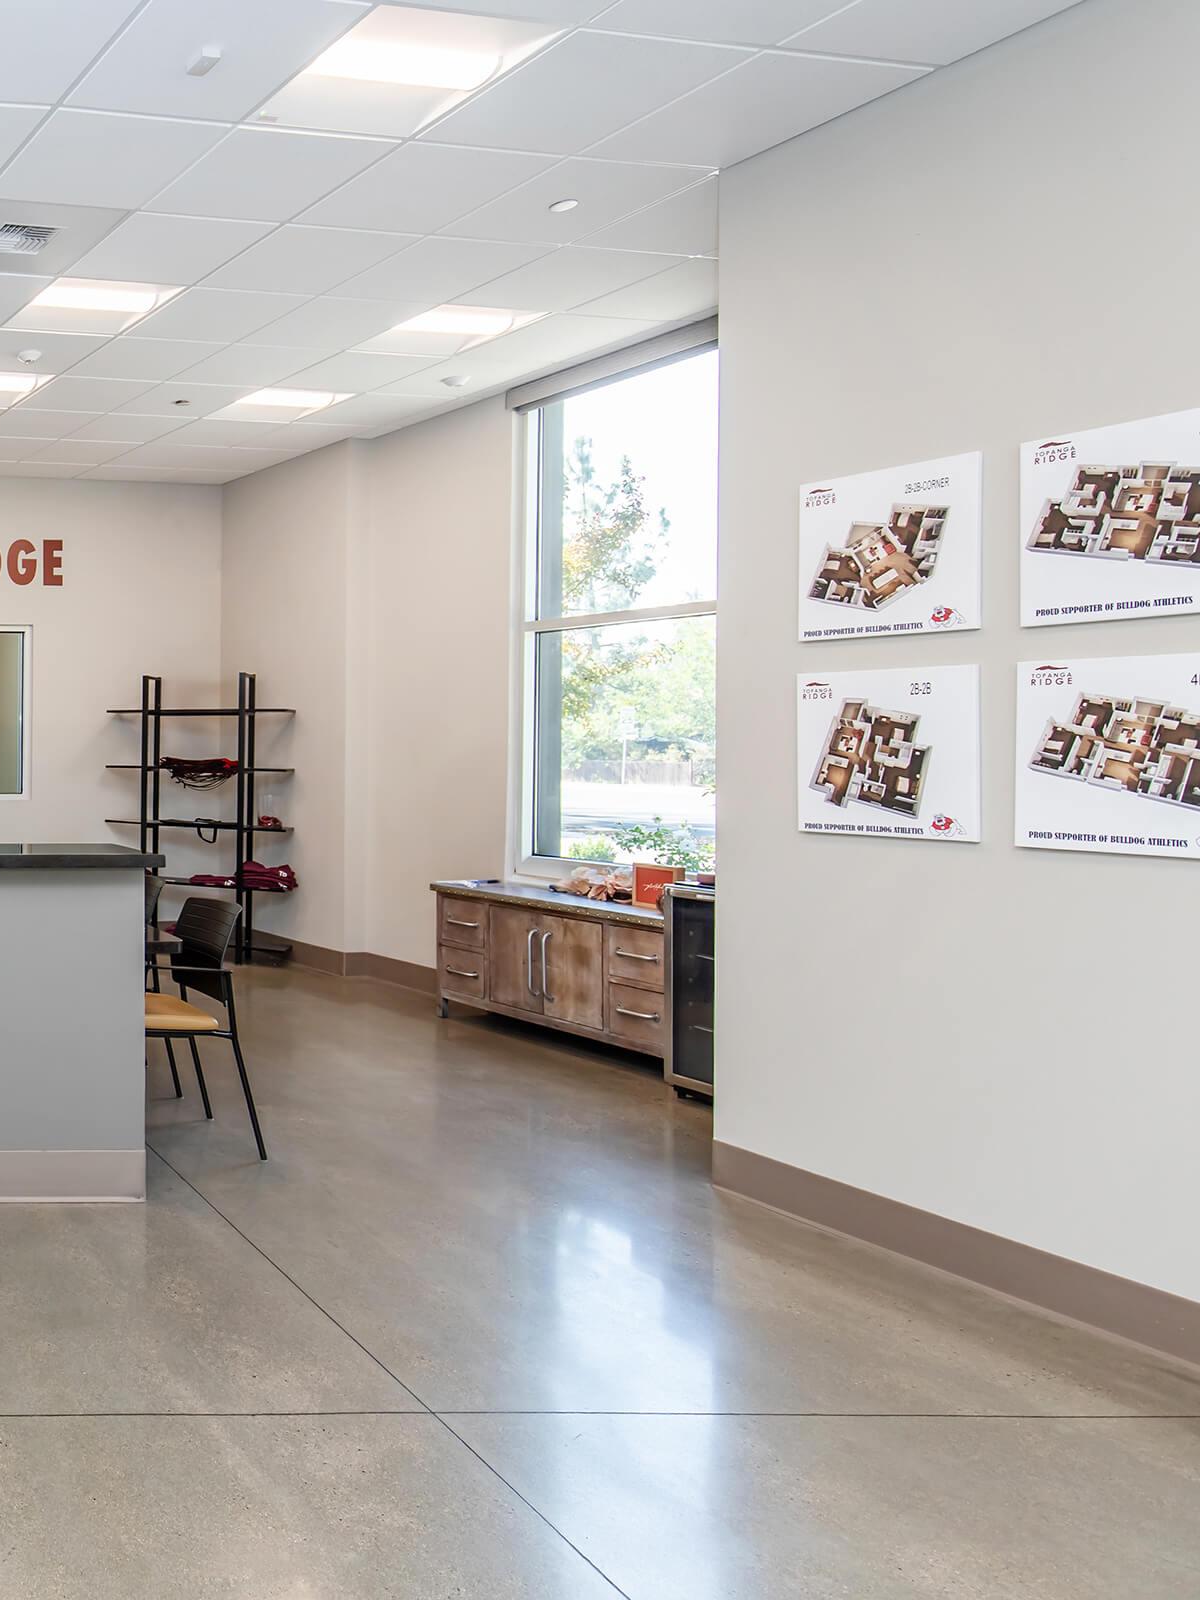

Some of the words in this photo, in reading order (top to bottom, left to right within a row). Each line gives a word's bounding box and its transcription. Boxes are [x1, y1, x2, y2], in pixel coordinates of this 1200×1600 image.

[1034, 451, 1076, 464] RIDGE
[1035, 446, 1075, 457] TOPANGA
[805, 497, 836, 508] RIDGE
[1035, 608, 1059, 617] PROUD
[1061, 604, 1102, 615] SUPPORTER
[1105, 603, 1114, 611] OF
[1116, 600, 1150, 610] BULLDOG
[1152, 596, 1193, 607] ATHLETICS
[803, 630, 822, 638] PROUD
[823, 628, 855, 636] SUPPORTER
[856, 626, 864, 634] OF
[865, 625, 891, 633] BULLDOG
[893, 622, 923, 631] ATHLETICS
[1031, 678, 1072, 686] RIDGE
[1191, 673, 1200, 686] 4
[910, 682, 931, 695] 2B-2B
[802, 692, 833, 700] RIDGE
[804, 822, 822, 830] PROUD
[823, 823, 855, 831] SUPPORTER
[857, 824, 864, 832] OF
[866, 825, 892, 833] BULLDOG
[894, 826, 924, 835] ATHLETICS
[1028, 831, 1052, 840] PROUD
[1054, 832, 1096, 842] SUPPORTER
[1099, 834, 1108, 843] OF
[1110, 835, 1145, 845] BULLDOG
[1148, 838, 1188, 848] ATHLETICS
